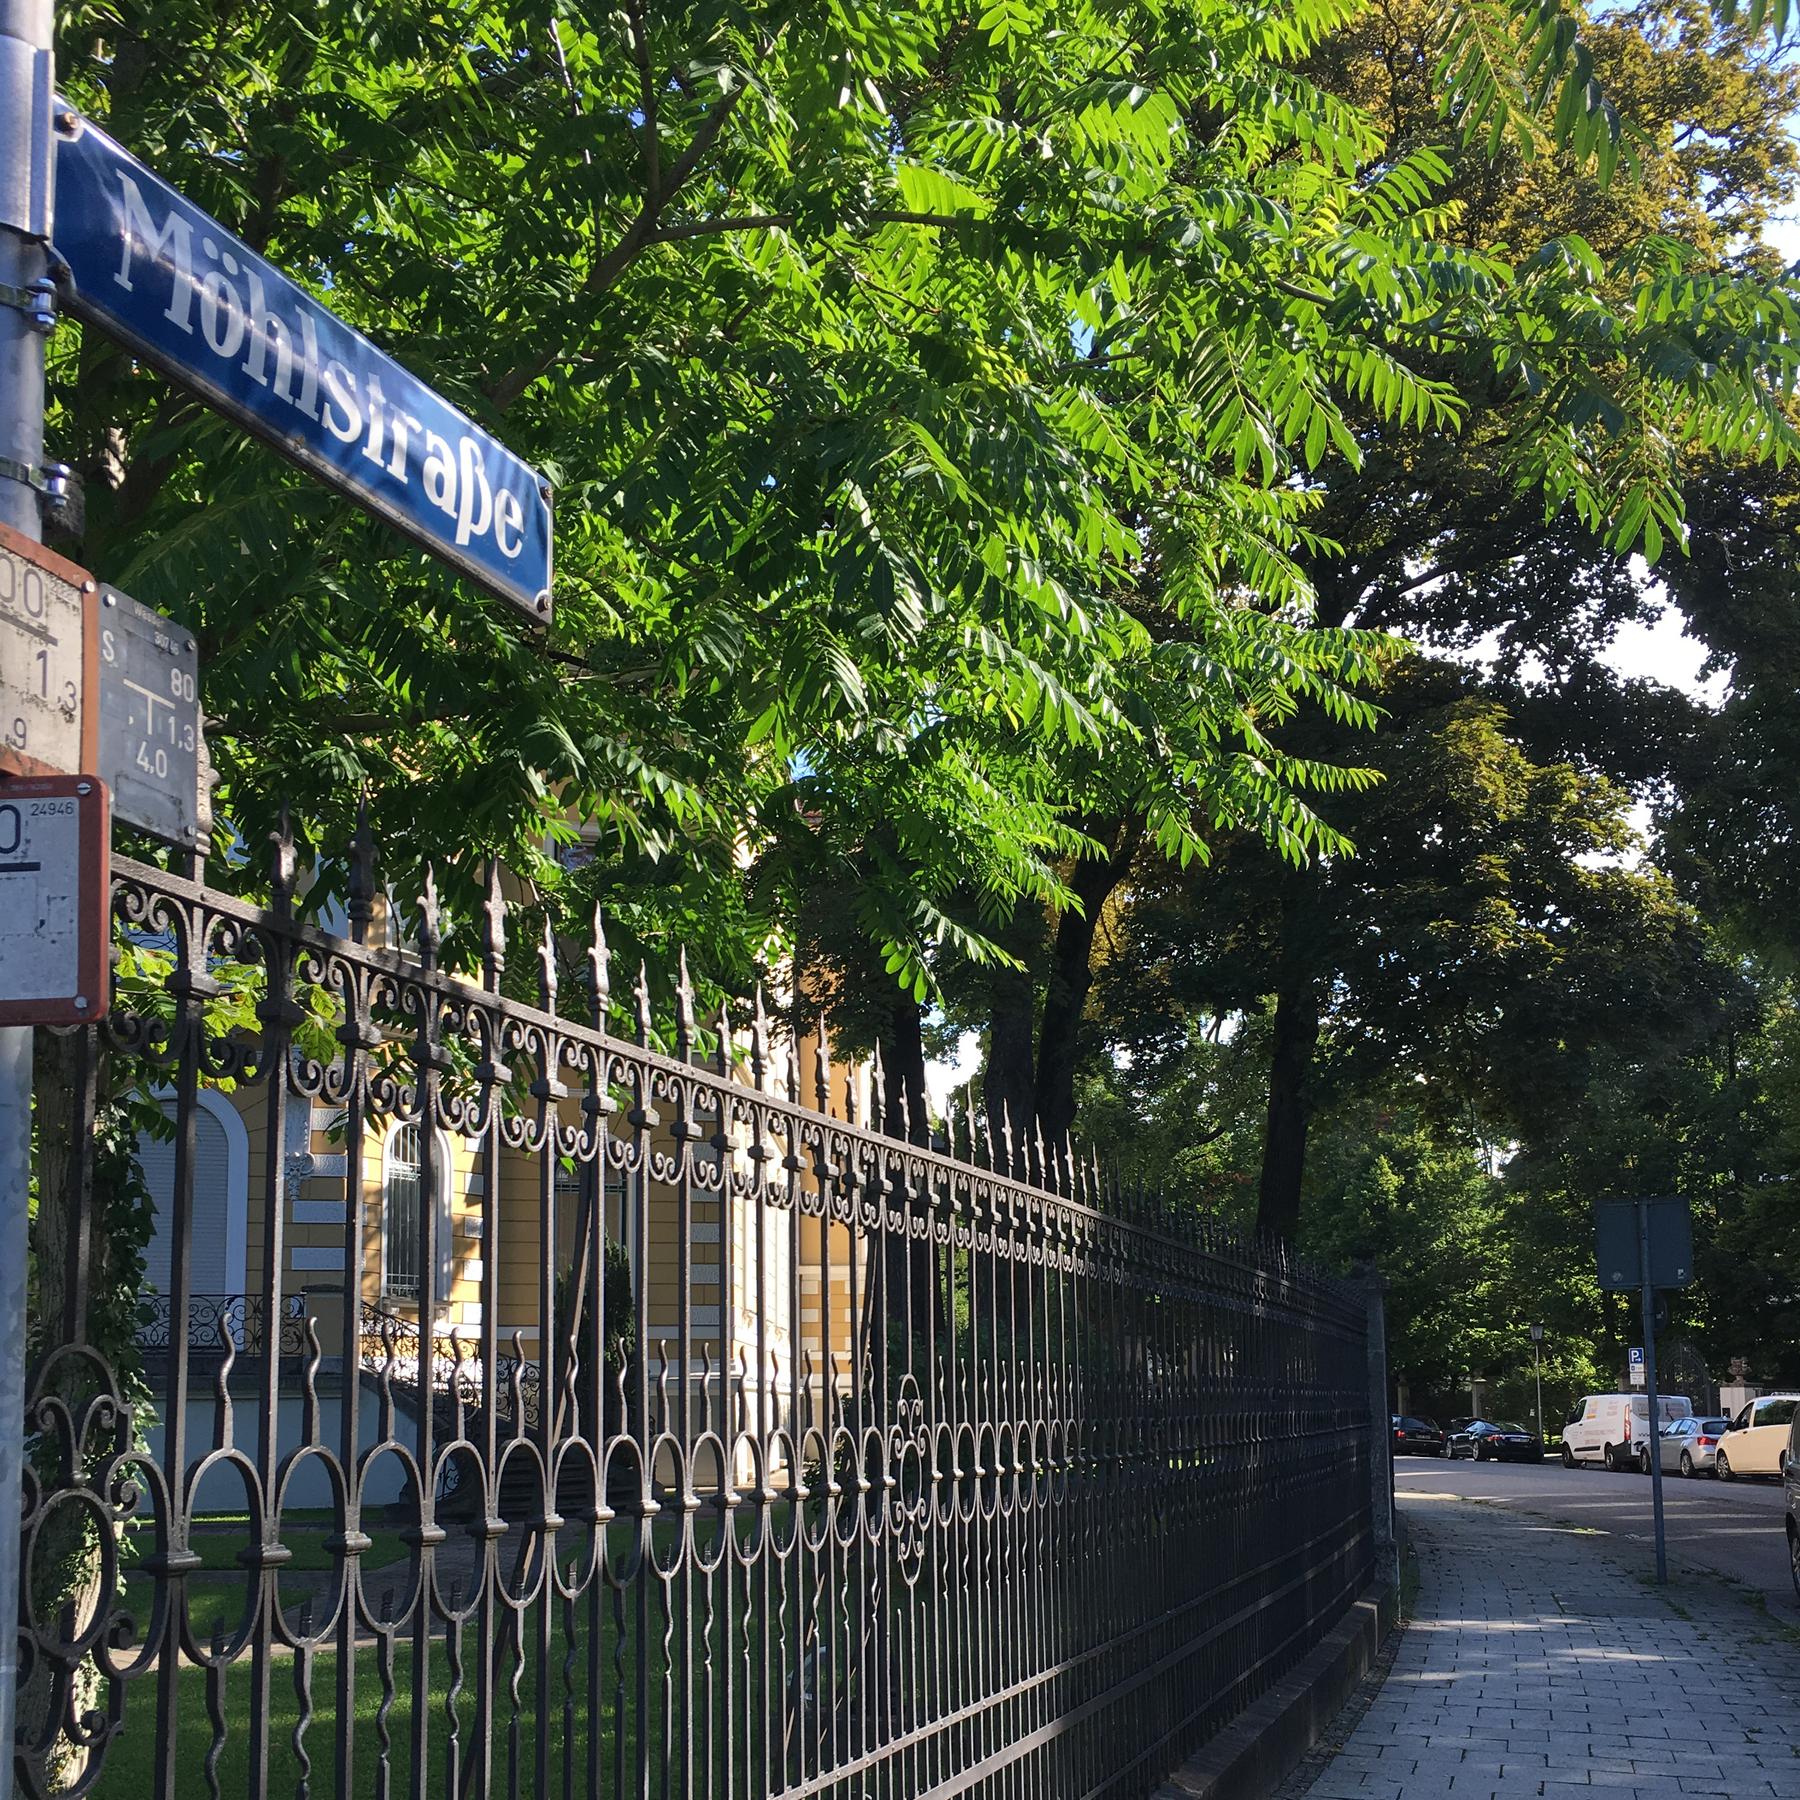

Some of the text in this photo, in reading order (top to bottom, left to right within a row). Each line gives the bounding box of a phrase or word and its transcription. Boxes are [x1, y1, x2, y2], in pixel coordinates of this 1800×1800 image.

[113, 168, 525, 560] Möhlstraße
[102, 629, 115, 662] S
[170, 667, 195, 703] 80
[168, 715, 195, 752] 1,3
[136, 740, 168, 778] 4,0
[31, 801, 74, 816] 24946
[1631, 1350, 1640, 1363] P
